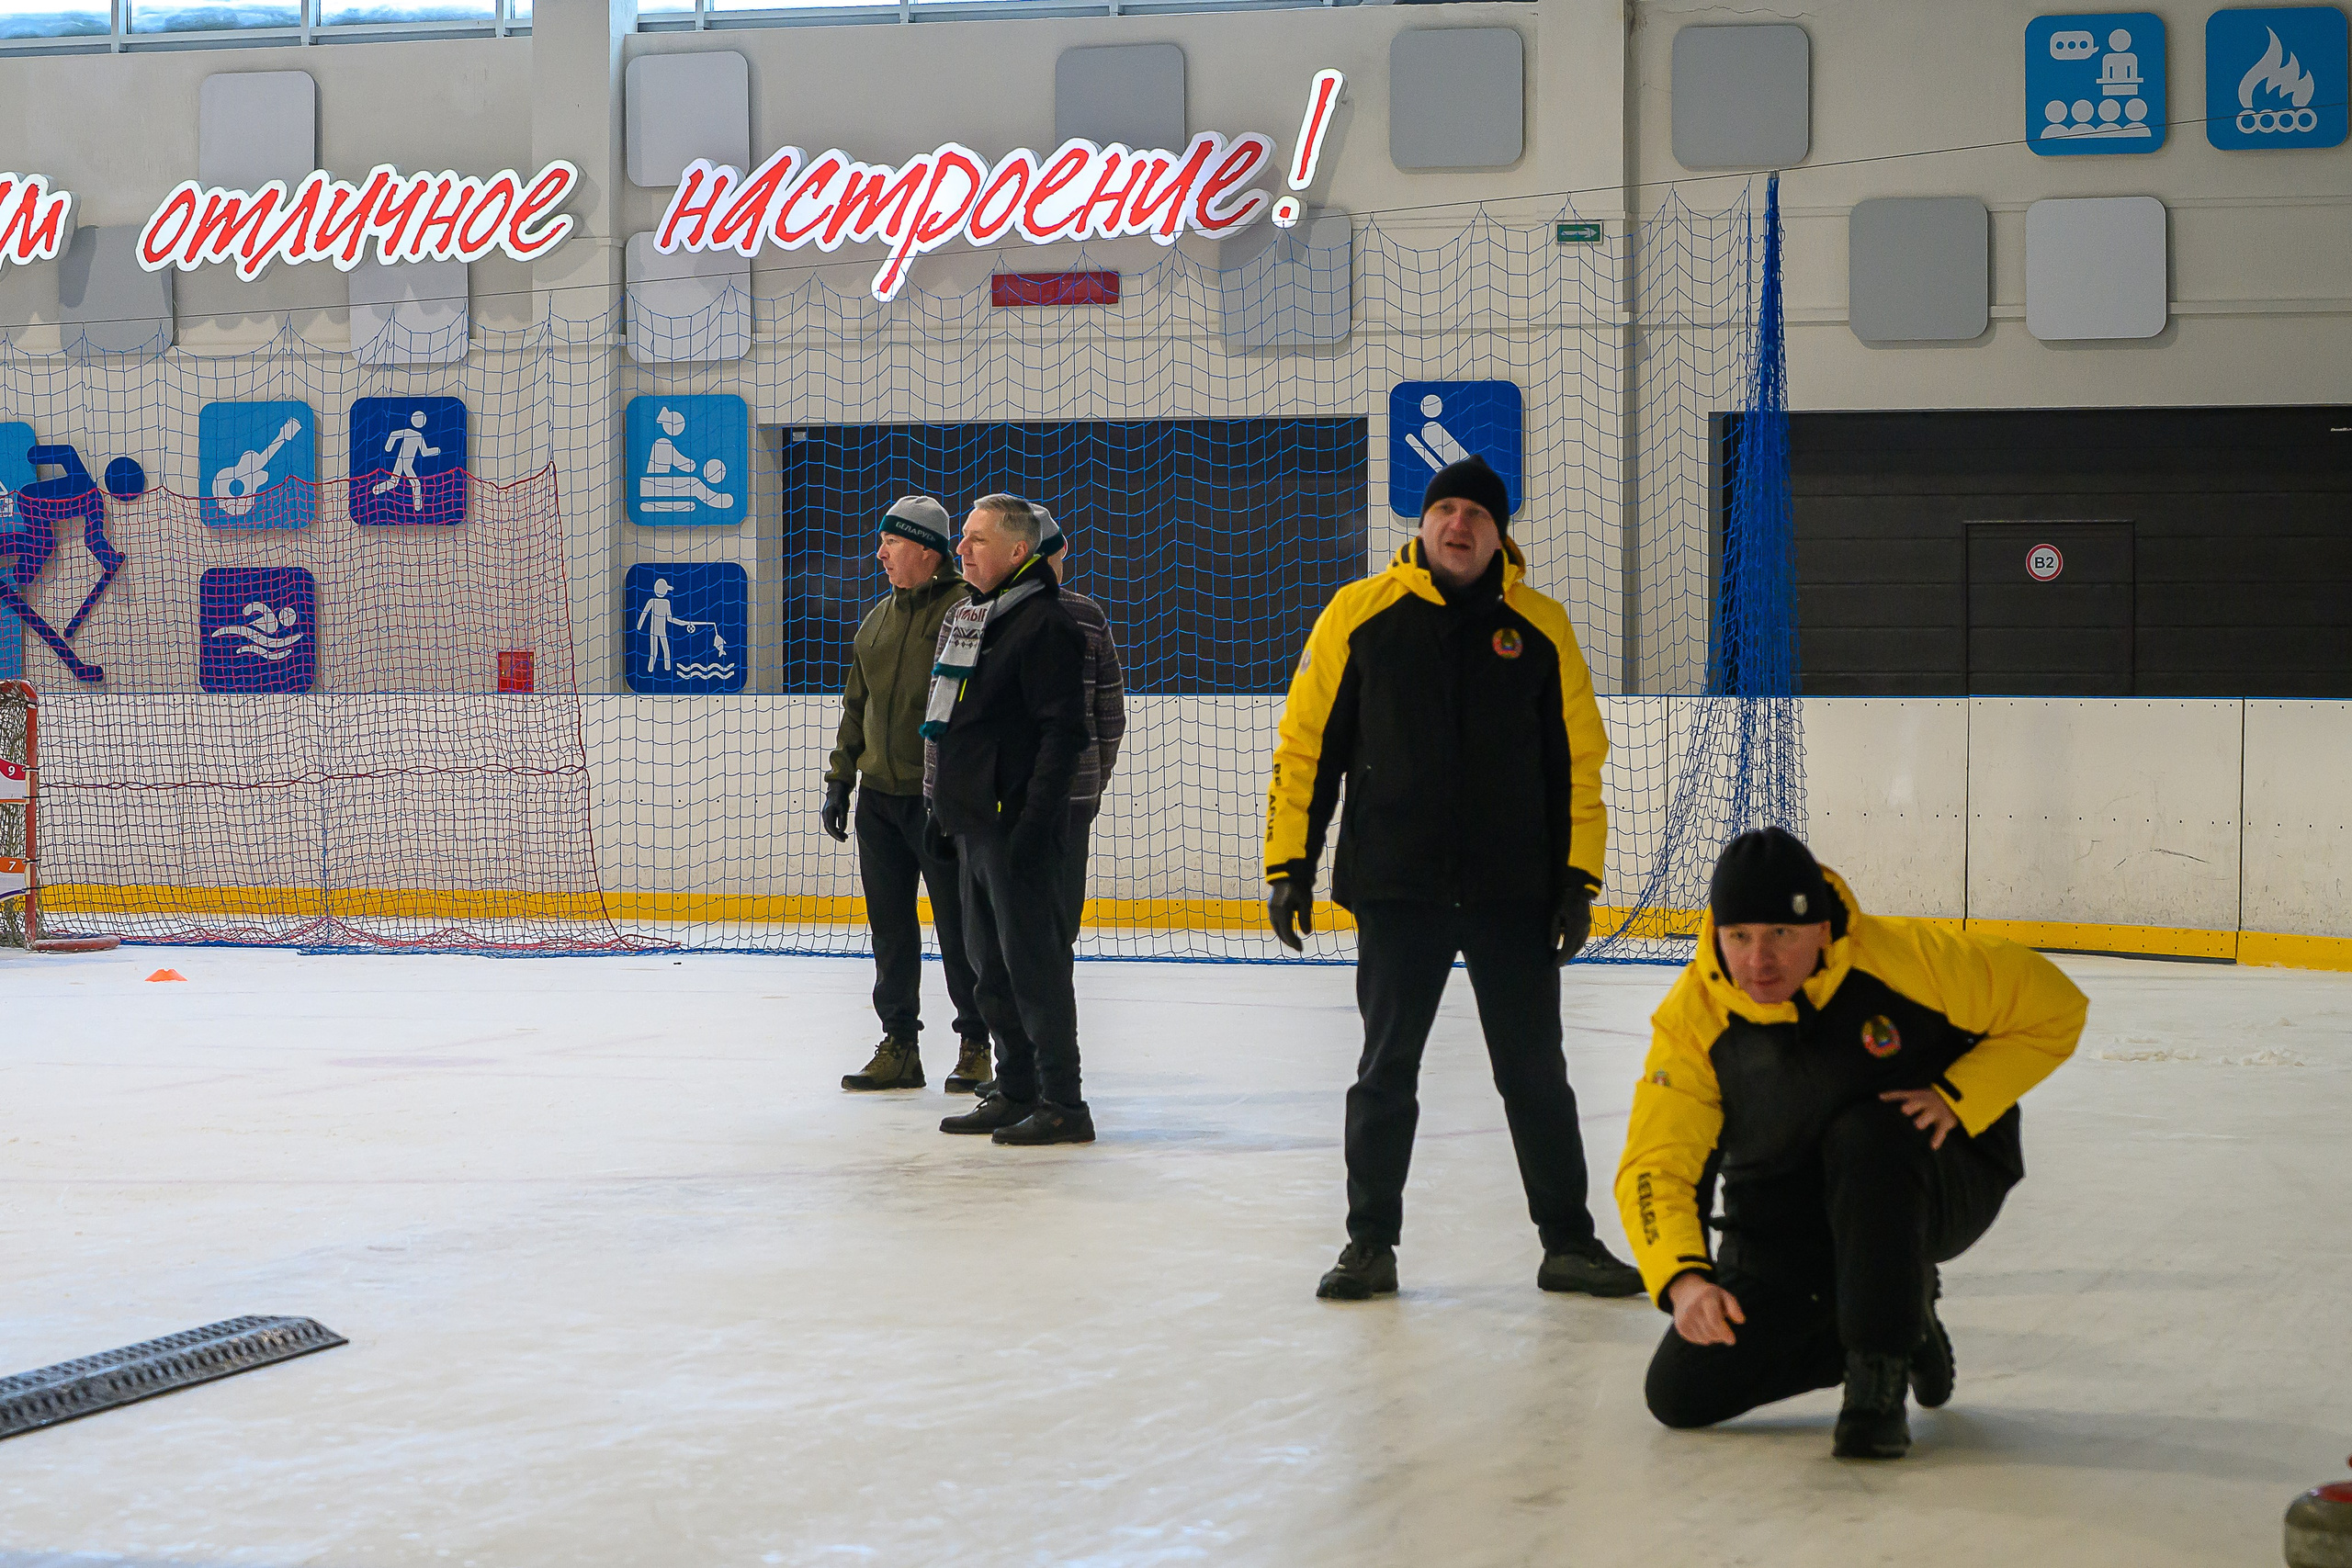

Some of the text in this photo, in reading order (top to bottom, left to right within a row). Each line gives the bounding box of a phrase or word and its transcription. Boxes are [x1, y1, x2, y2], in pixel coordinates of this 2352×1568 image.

[142, 168, 571, 274] отличное
[661, 77, 1335, 294] настроение!
[7, 764, 17, 776] 9
[8, 861, 17, 872] 7
